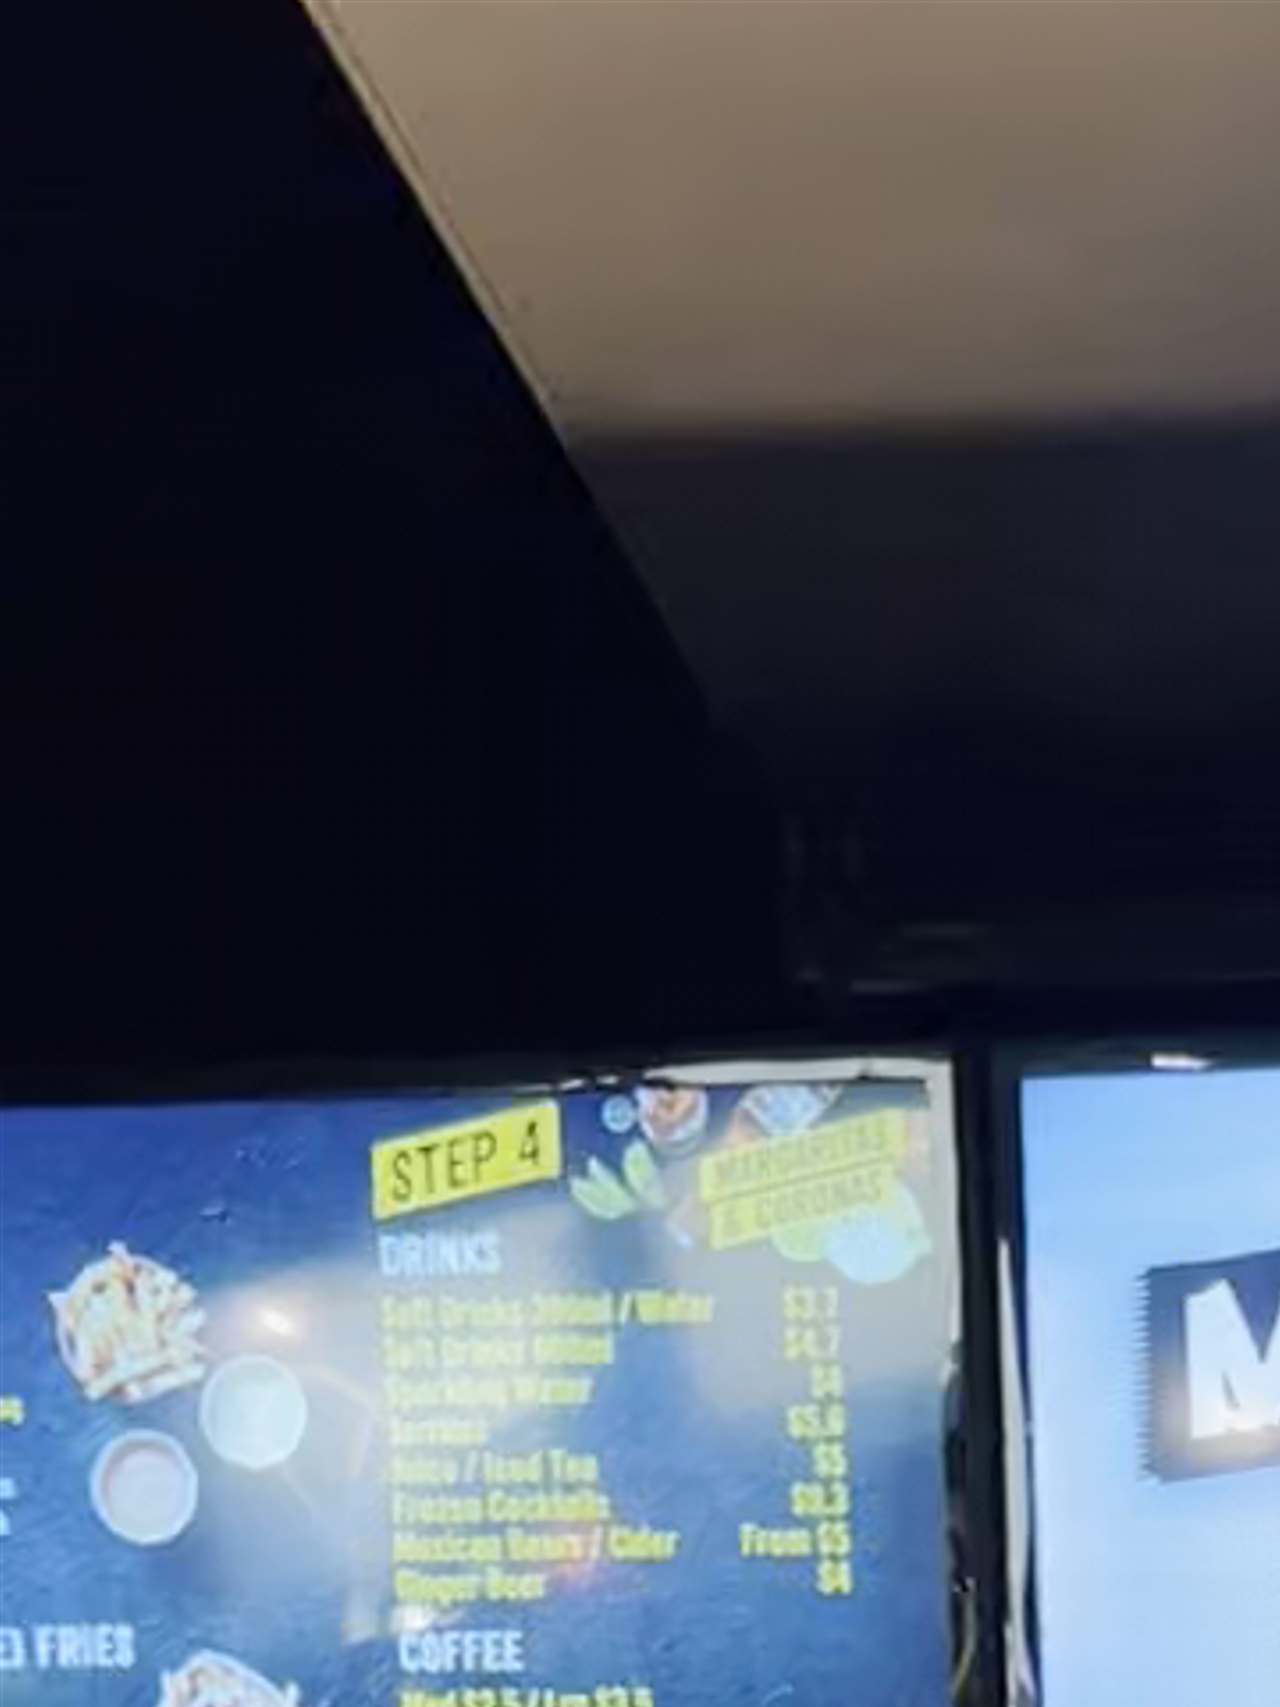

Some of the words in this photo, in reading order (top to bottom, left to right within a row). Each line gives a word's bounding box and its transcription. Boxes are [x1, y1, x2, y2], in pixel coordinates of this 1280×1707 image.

[391, 1132, 497, 1203] STEP
[518, 1119, 542, 1168] 4
[379, 1229, 501, 1277] DRINKS
[34, 1622, 135, 1669] FRIES
[399, 1630, 525, 1673] COFFEE
